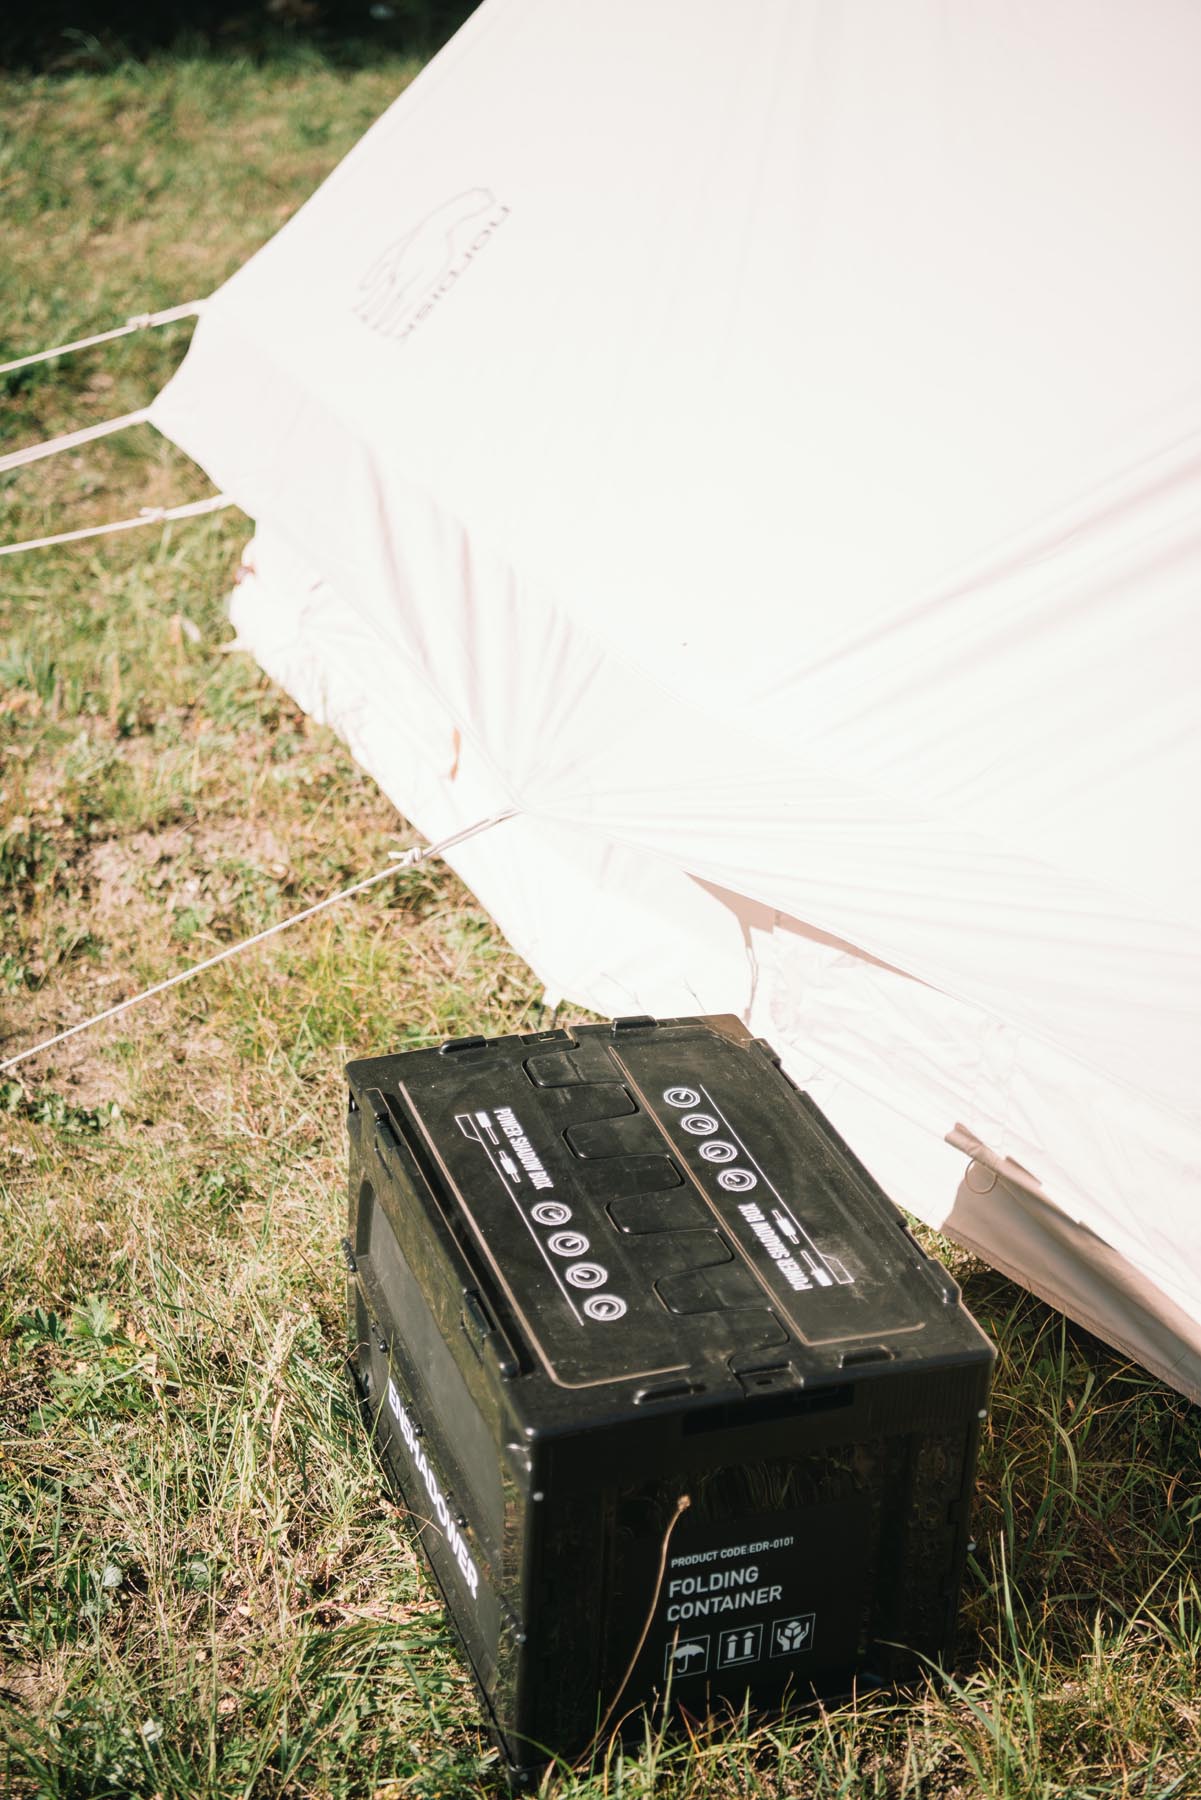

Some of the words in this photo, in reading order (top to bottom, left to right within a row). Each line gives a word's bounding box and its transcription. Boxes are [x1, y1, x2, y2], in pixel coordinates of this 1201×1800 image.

[493, 1107, 523, 1138] POWER
[509, 1136, 544, 1171] SHADOW
[528, 1171, 554, 1190] BOX
[737, 1202, 765, 1223] BOX
[750, 1222, 790, 1259] SHADOW
[776, 1257, 813, 1291] POWER
[388, 1377, 479, 1600] ENSHADOWER
[671, 1551, 719, 1568] PRODUCT
[669, 1566, 759, 1598] FOLDING
[667, 1585, 783, 1622] CONTAINER
